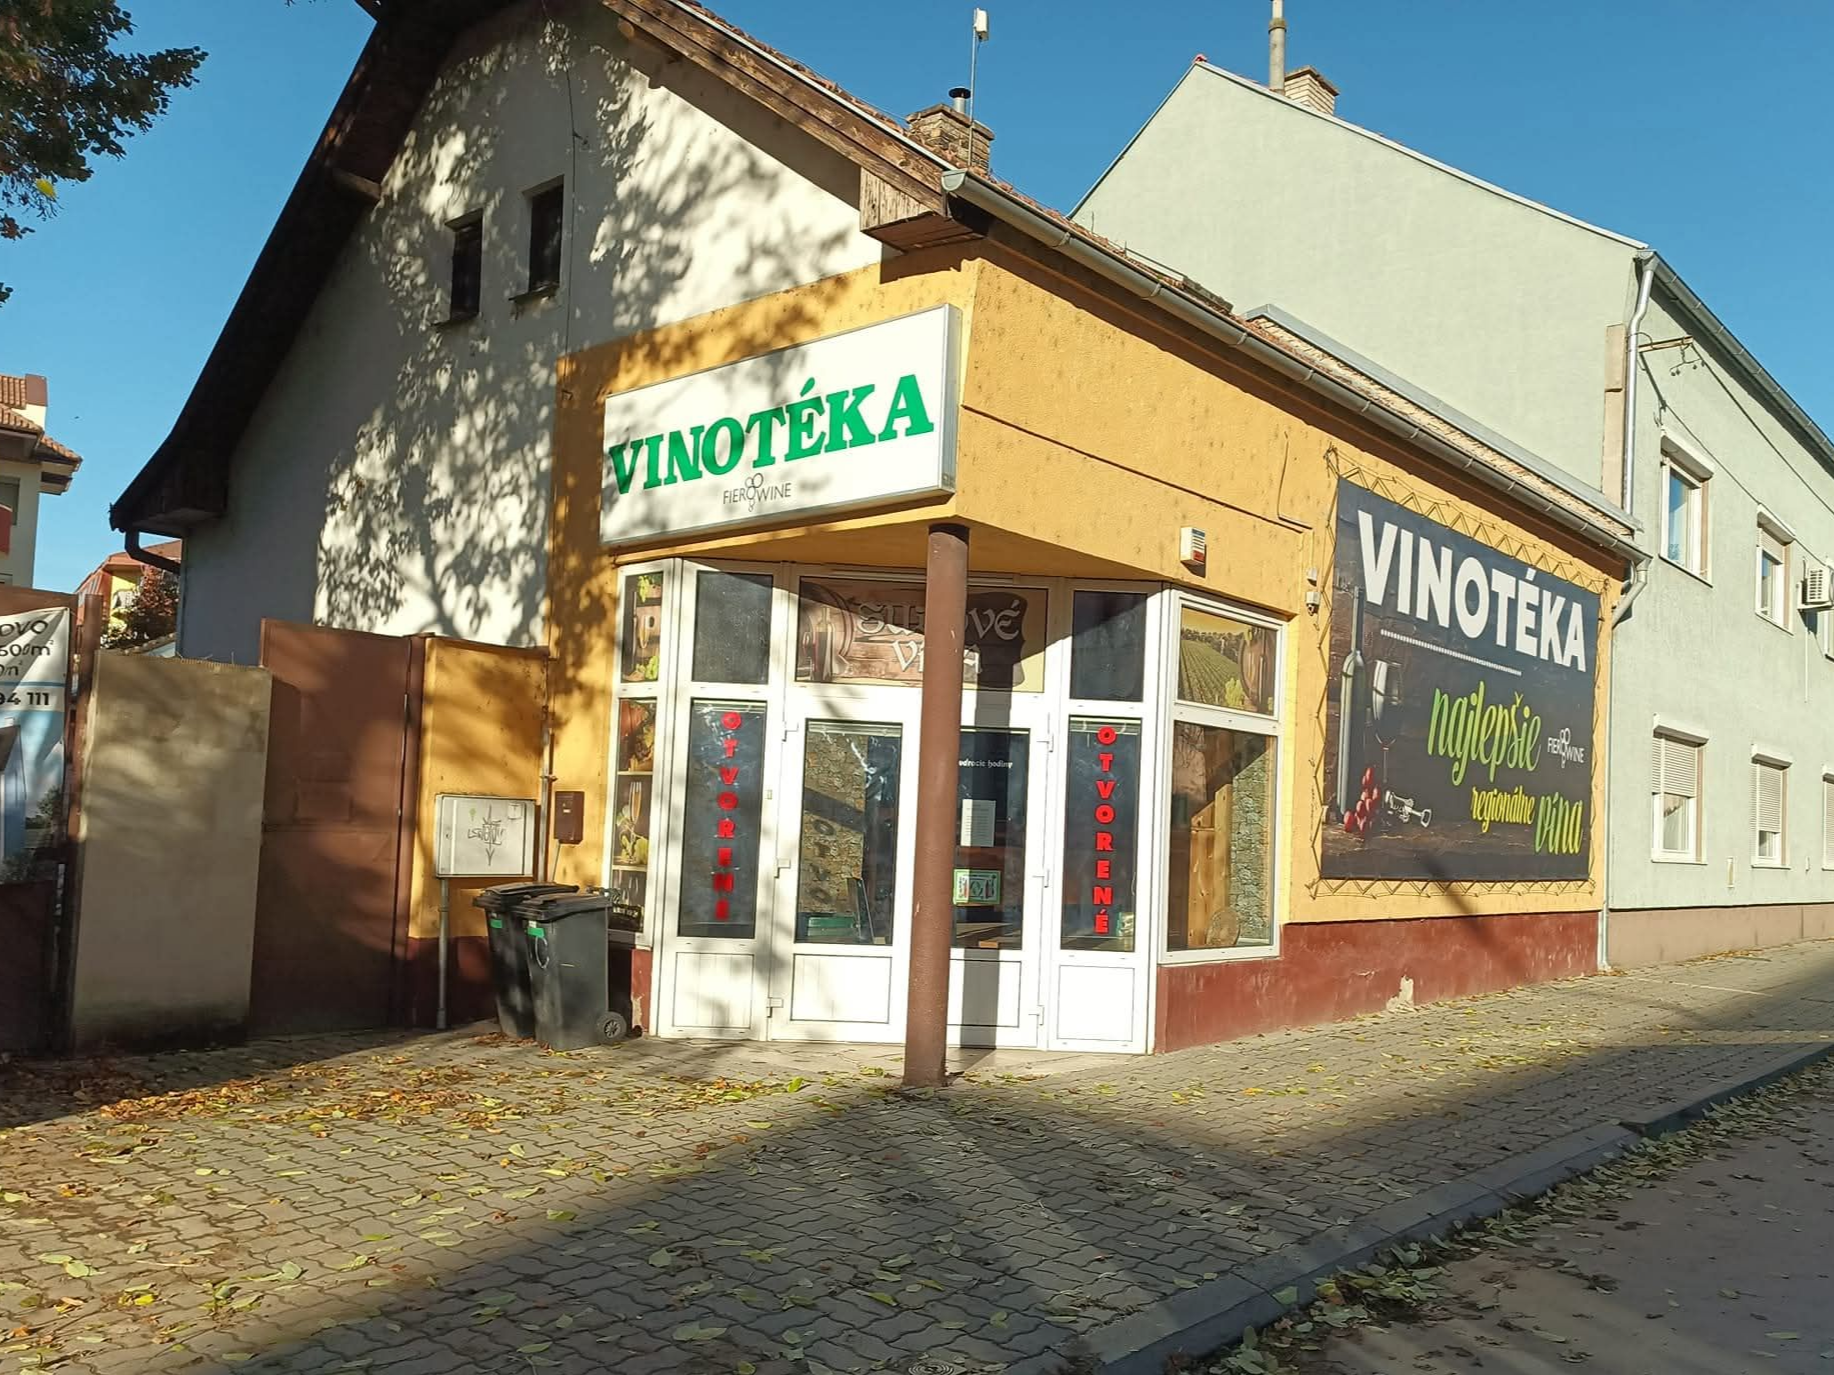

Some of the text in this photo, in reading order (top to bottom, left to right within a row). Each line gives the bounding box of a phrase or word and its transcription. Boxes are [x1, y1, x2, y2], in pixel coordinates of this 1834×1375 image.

[608, 374, 934, 495] VINOTÉKA
[1357, 510, 1586, 672] VINOTÉKA
[1427, 680, 1542, 786] najlepšie
[1093, 726, 1117, 934] OTVORENÉ
[1470, 785, 1584, 855] regionálne vína
